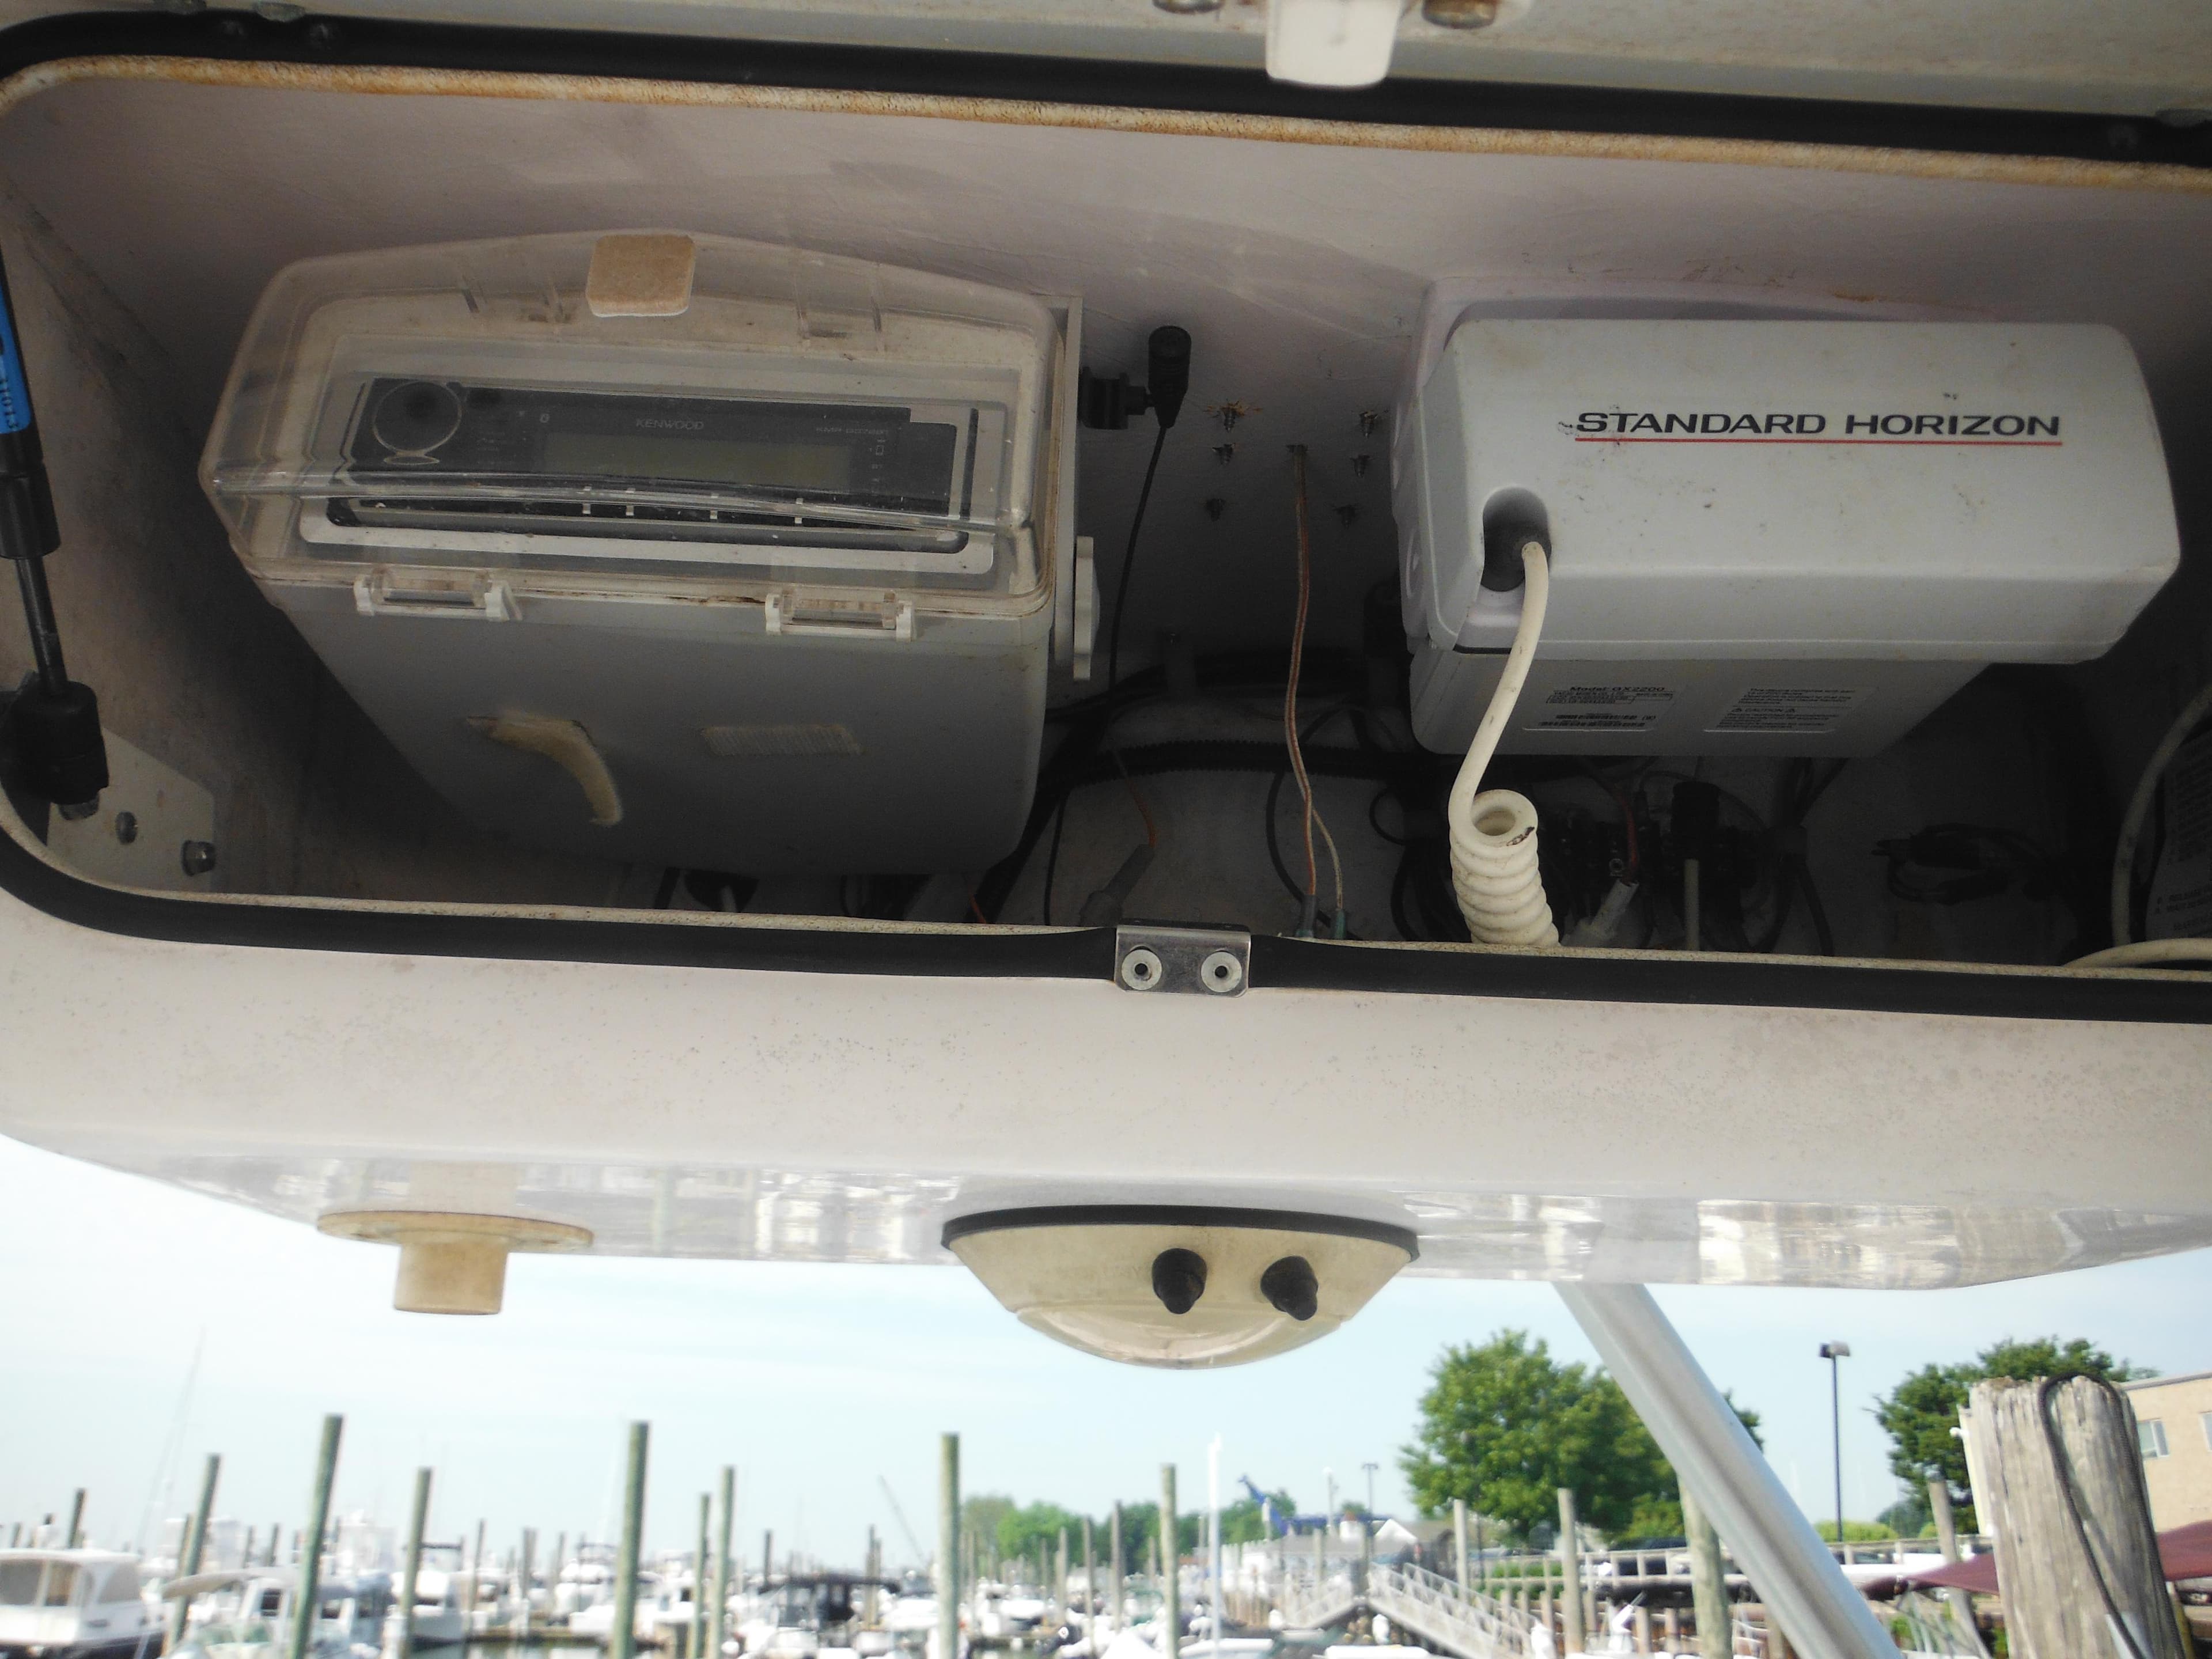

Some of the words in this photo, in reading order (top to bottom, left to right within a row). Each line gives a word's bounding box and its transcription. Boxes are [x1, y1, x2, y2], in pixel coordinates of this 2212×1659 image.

[635, 419, 704, 430] KENWOOD
[1576, 412, 1826, 434] STANDARD
[1845, 414, 2061, 437] HORIZON
